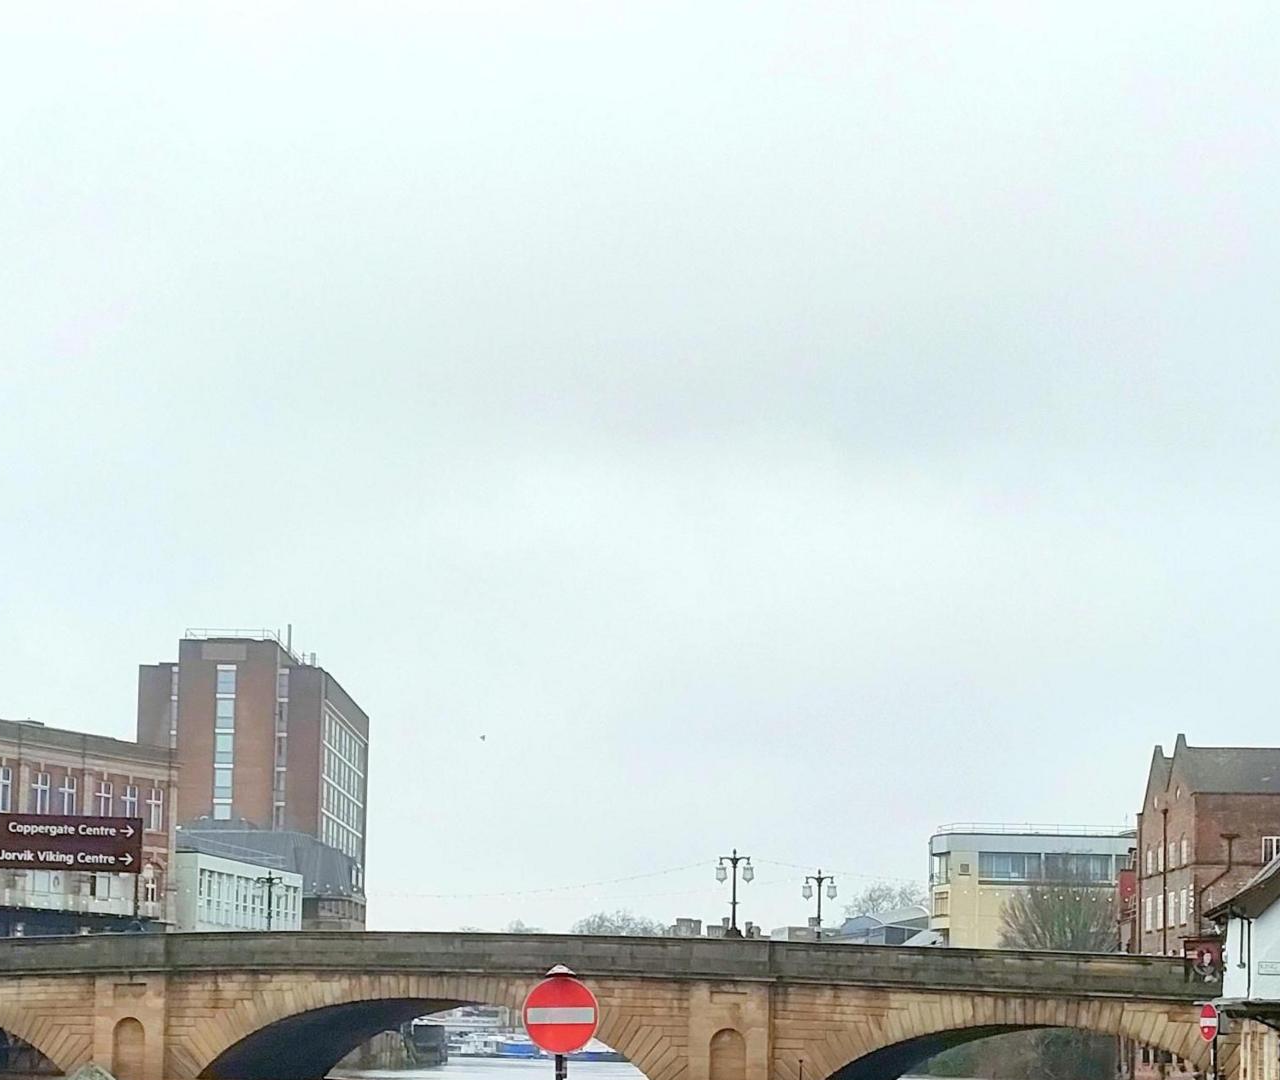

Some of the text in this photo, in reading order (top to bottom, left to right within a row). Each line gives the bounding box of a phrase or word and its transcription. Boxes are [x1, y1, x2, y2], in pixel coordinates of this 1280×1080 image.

[8, 822, 117, 836] Coppergate Centre
[37, 850, 74, 865] Viking
[77, 852, 116, 864] Centre
